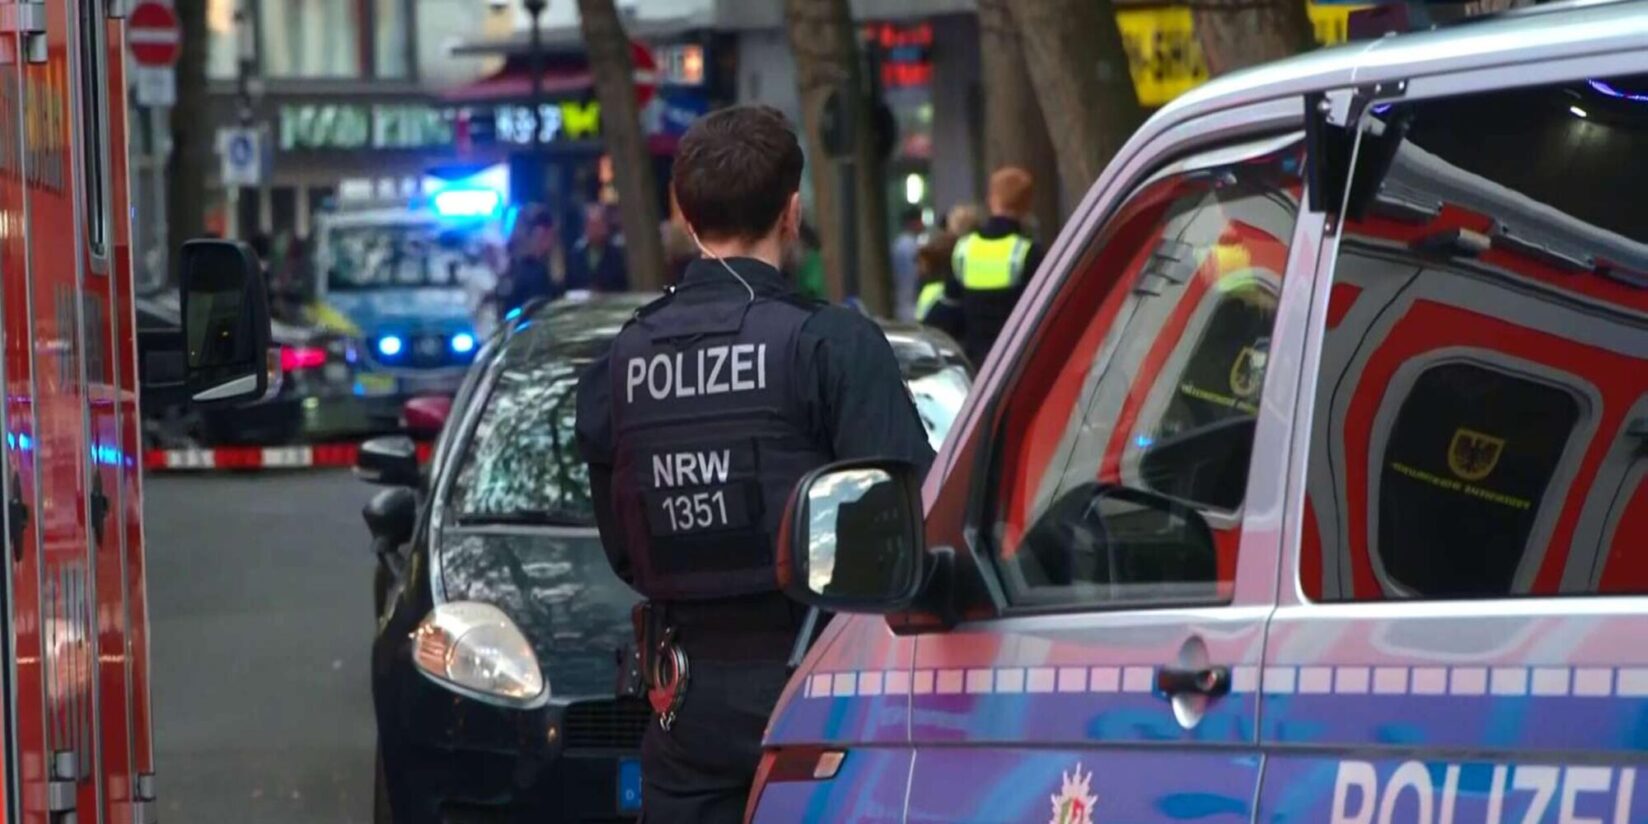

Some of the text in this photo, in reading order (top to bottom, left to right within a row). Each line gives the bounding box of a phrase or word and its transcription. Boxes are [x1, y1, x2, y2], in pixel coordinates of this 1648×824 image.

[626, 343, 766, 403] POLIZEI
[652, 449, 730, 488] NRW
[662, 490, 728, 531] 1351
